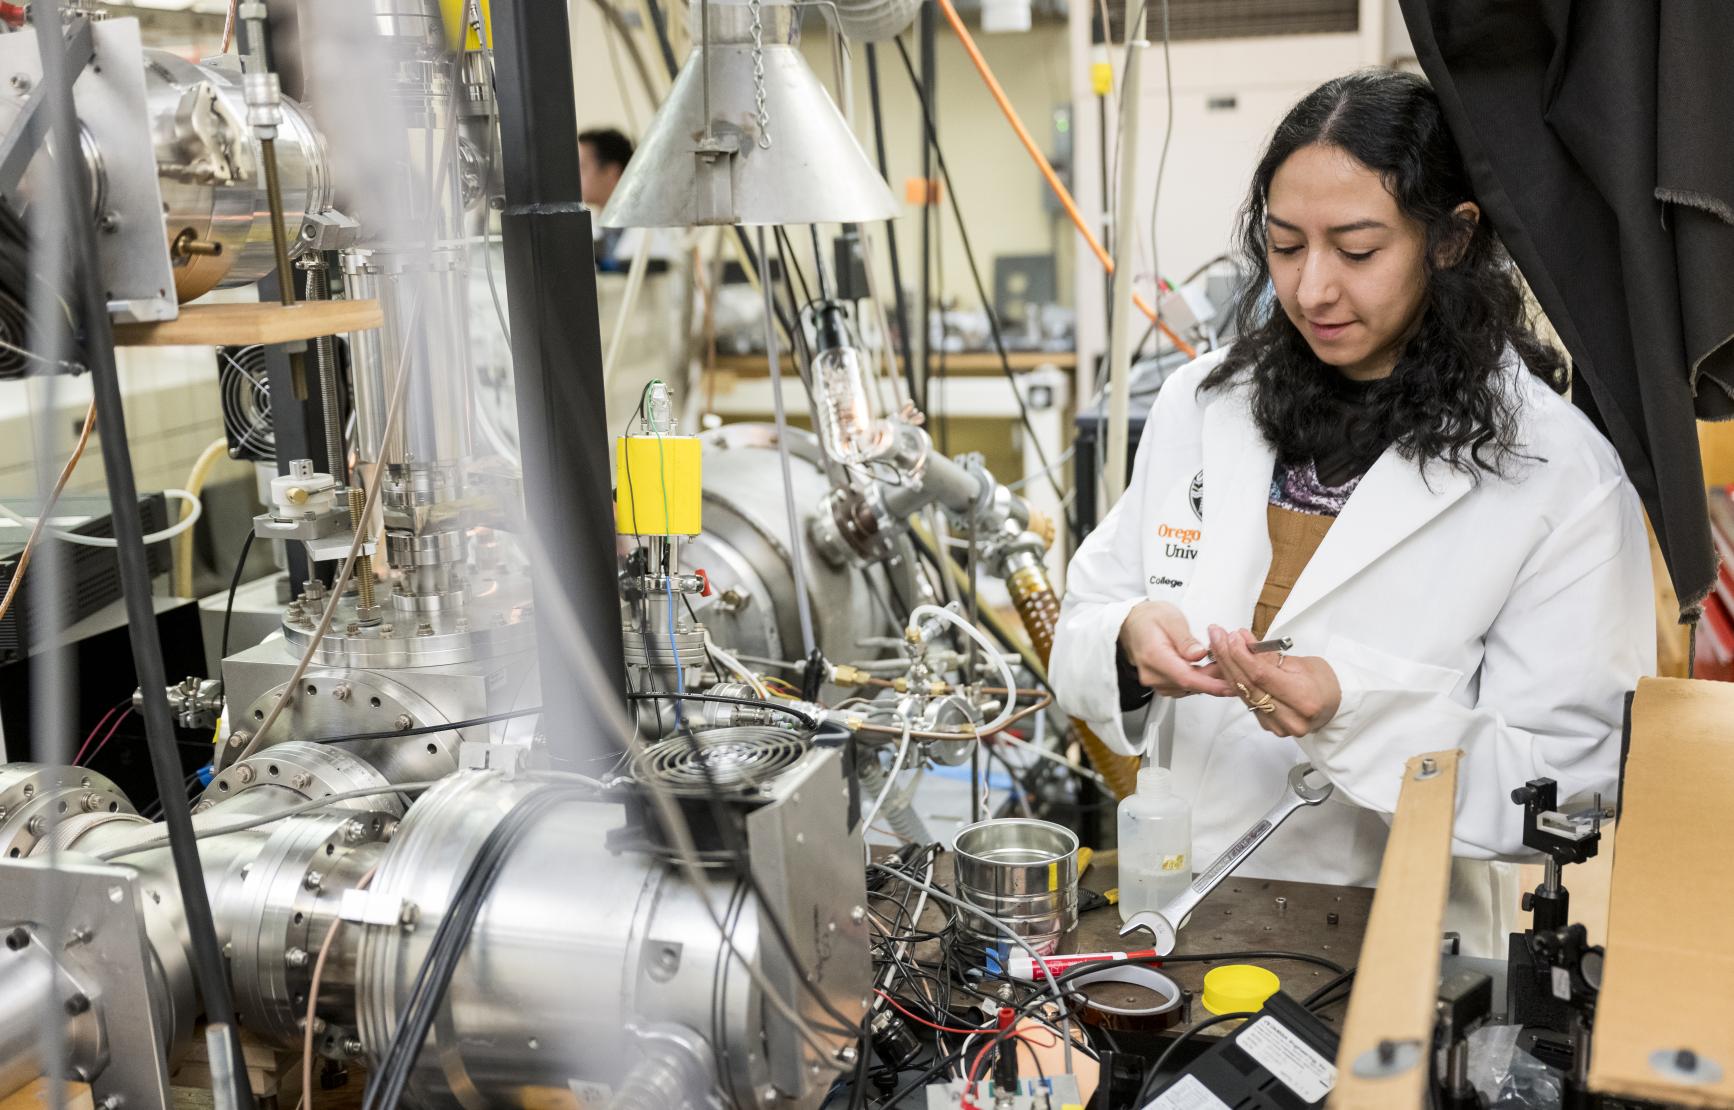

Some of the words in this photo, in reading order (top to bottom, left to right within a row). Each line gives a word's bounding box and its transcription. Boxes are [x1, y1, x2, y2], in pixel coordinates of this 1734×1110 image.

[1158, 523, 1201, 543] Orego
[1165, 543, 1198, 560] Univ
[1149, 575, 1183, 588] College
